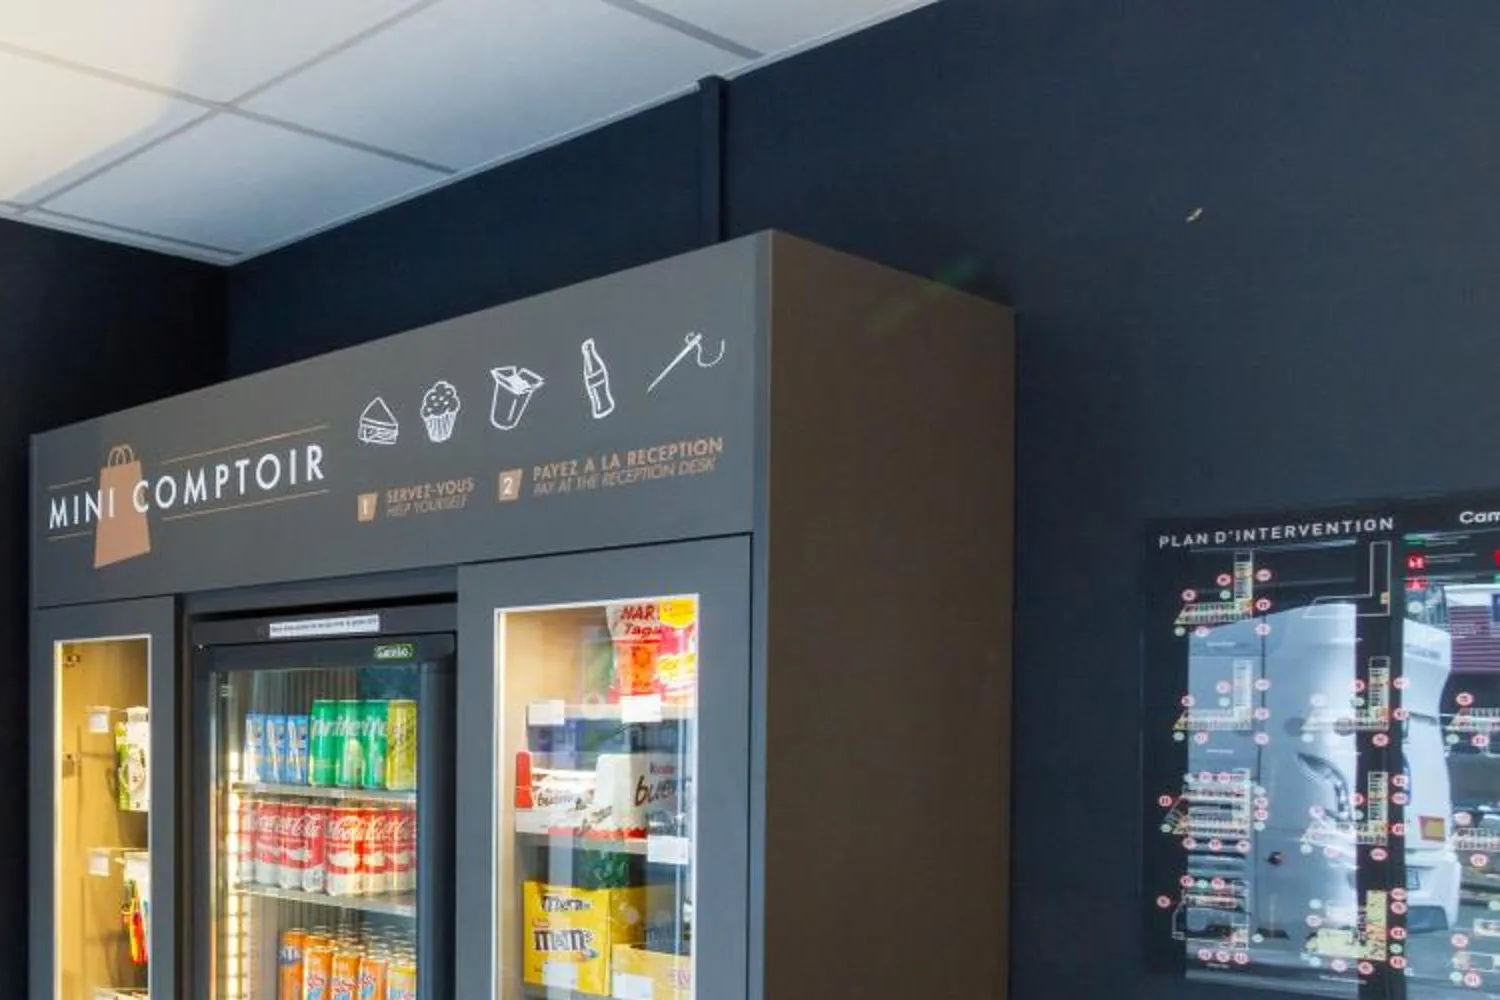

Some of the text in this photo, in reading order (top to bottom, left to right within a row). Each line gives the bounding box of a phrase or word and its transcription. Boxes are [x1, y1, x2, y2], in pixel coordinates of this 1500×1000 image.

[533, 459, 578, 481] PAYEZ
[601, 453, 621, 471] LA
[627, 436, 724, 466] RECEPTION
[49, 444, 325, 529] MINI COMPTOIR
[387, 476, 476, 503] SERVEZ-VOUS
[503, 476, 513, 496] 2
[1159, 532, 1209, 549] PLAN
[1214, 516, 1394, 545] D'INTERVENTION
